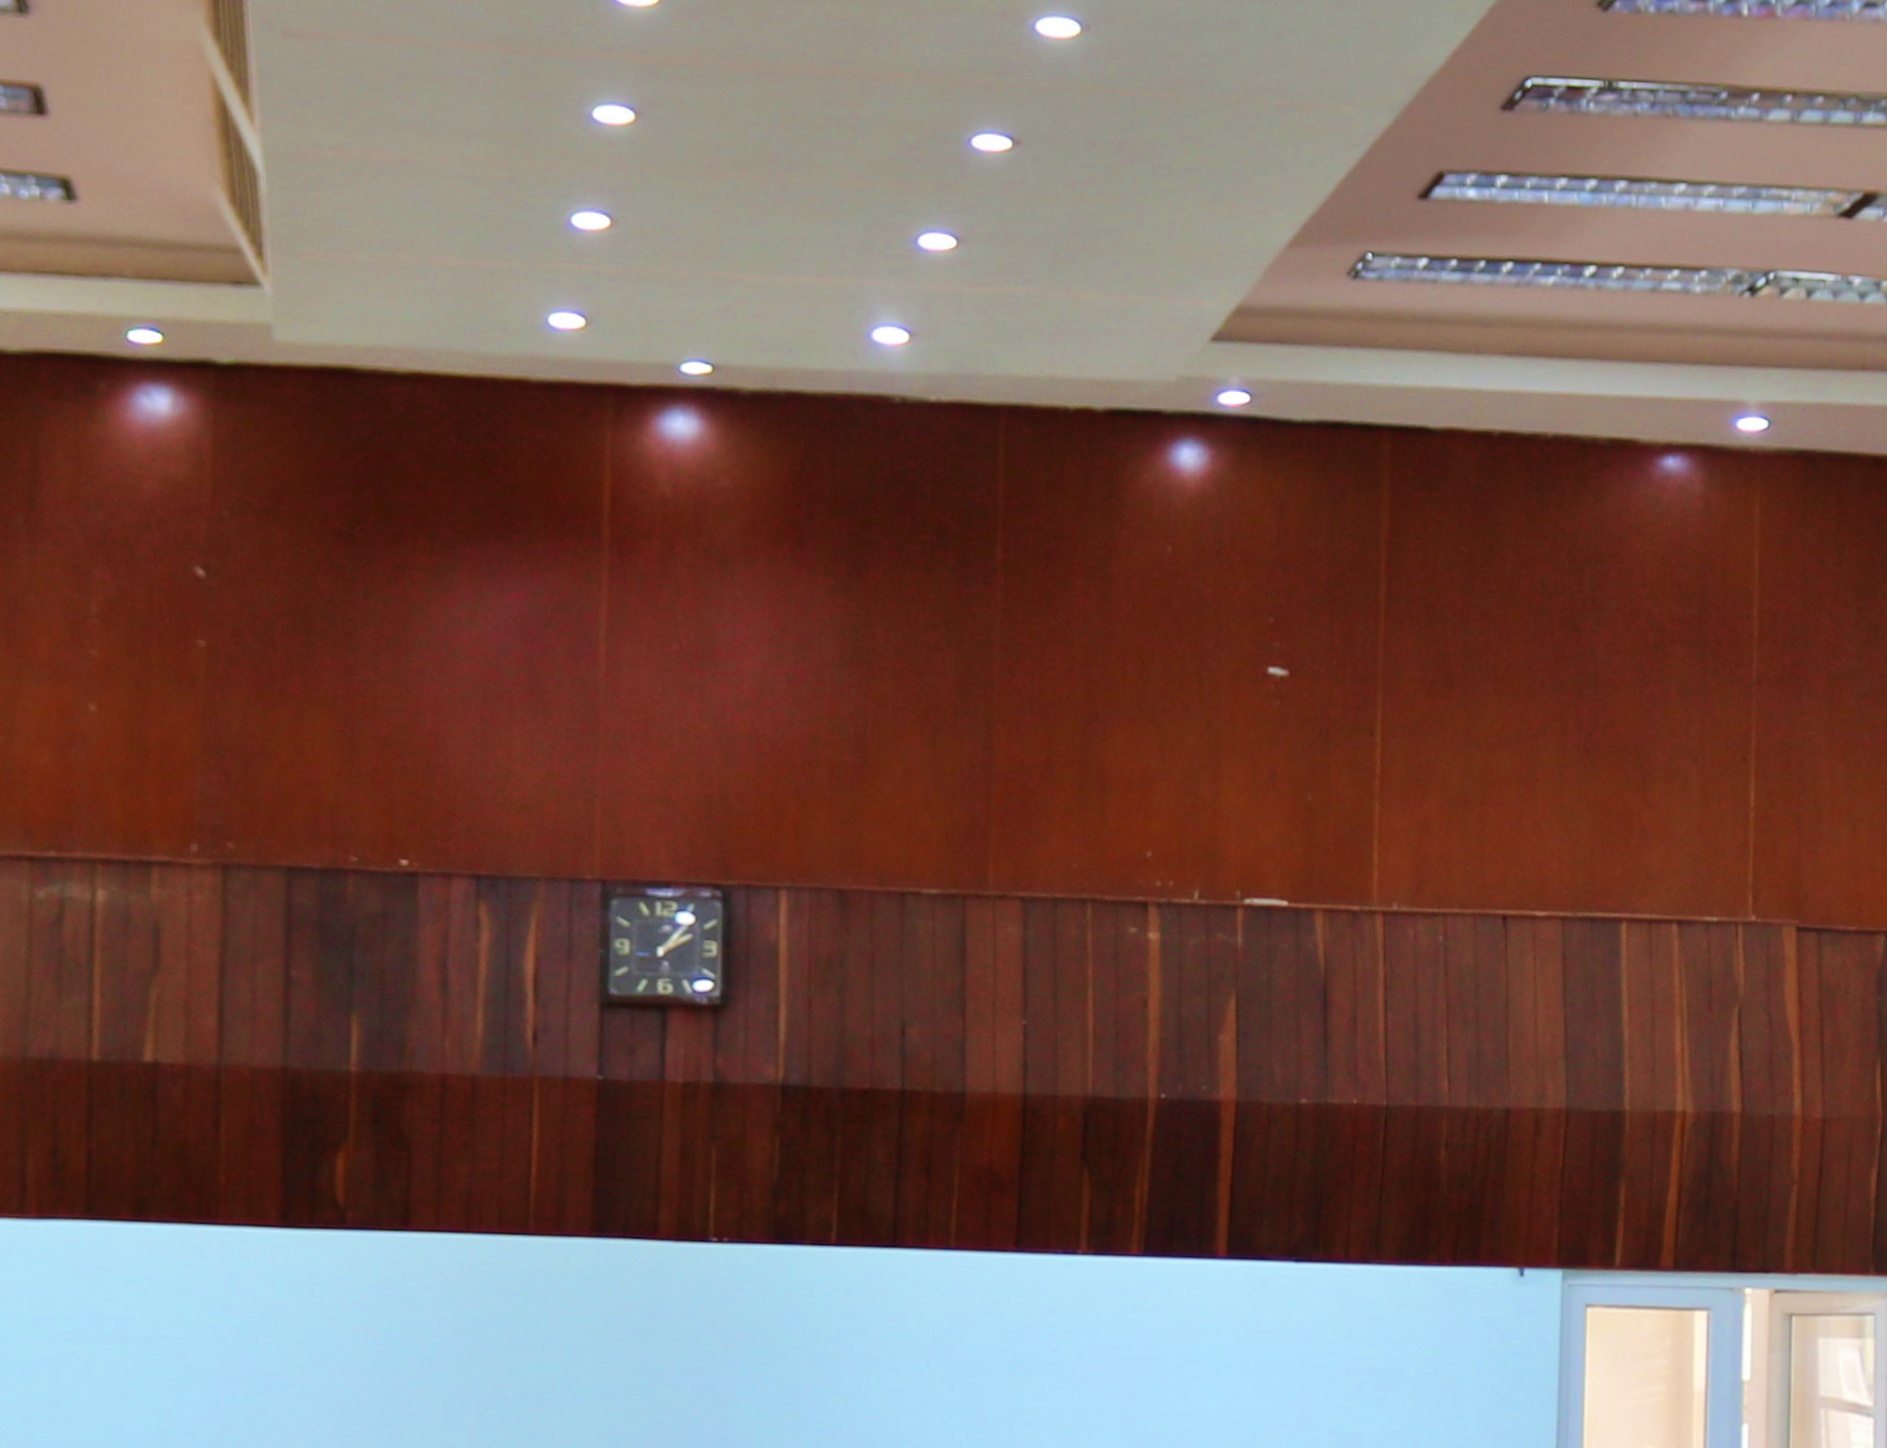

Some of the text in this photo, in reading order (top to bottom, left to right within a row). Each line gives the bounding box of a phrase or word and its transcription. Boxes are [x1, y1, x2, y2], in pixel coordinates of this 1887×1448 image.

[655, 900, 679, 917] 12
[614, 938, 630, 956] 9
[702, 940, 718, 957] 3
[656, 978, 674, 995] 6
